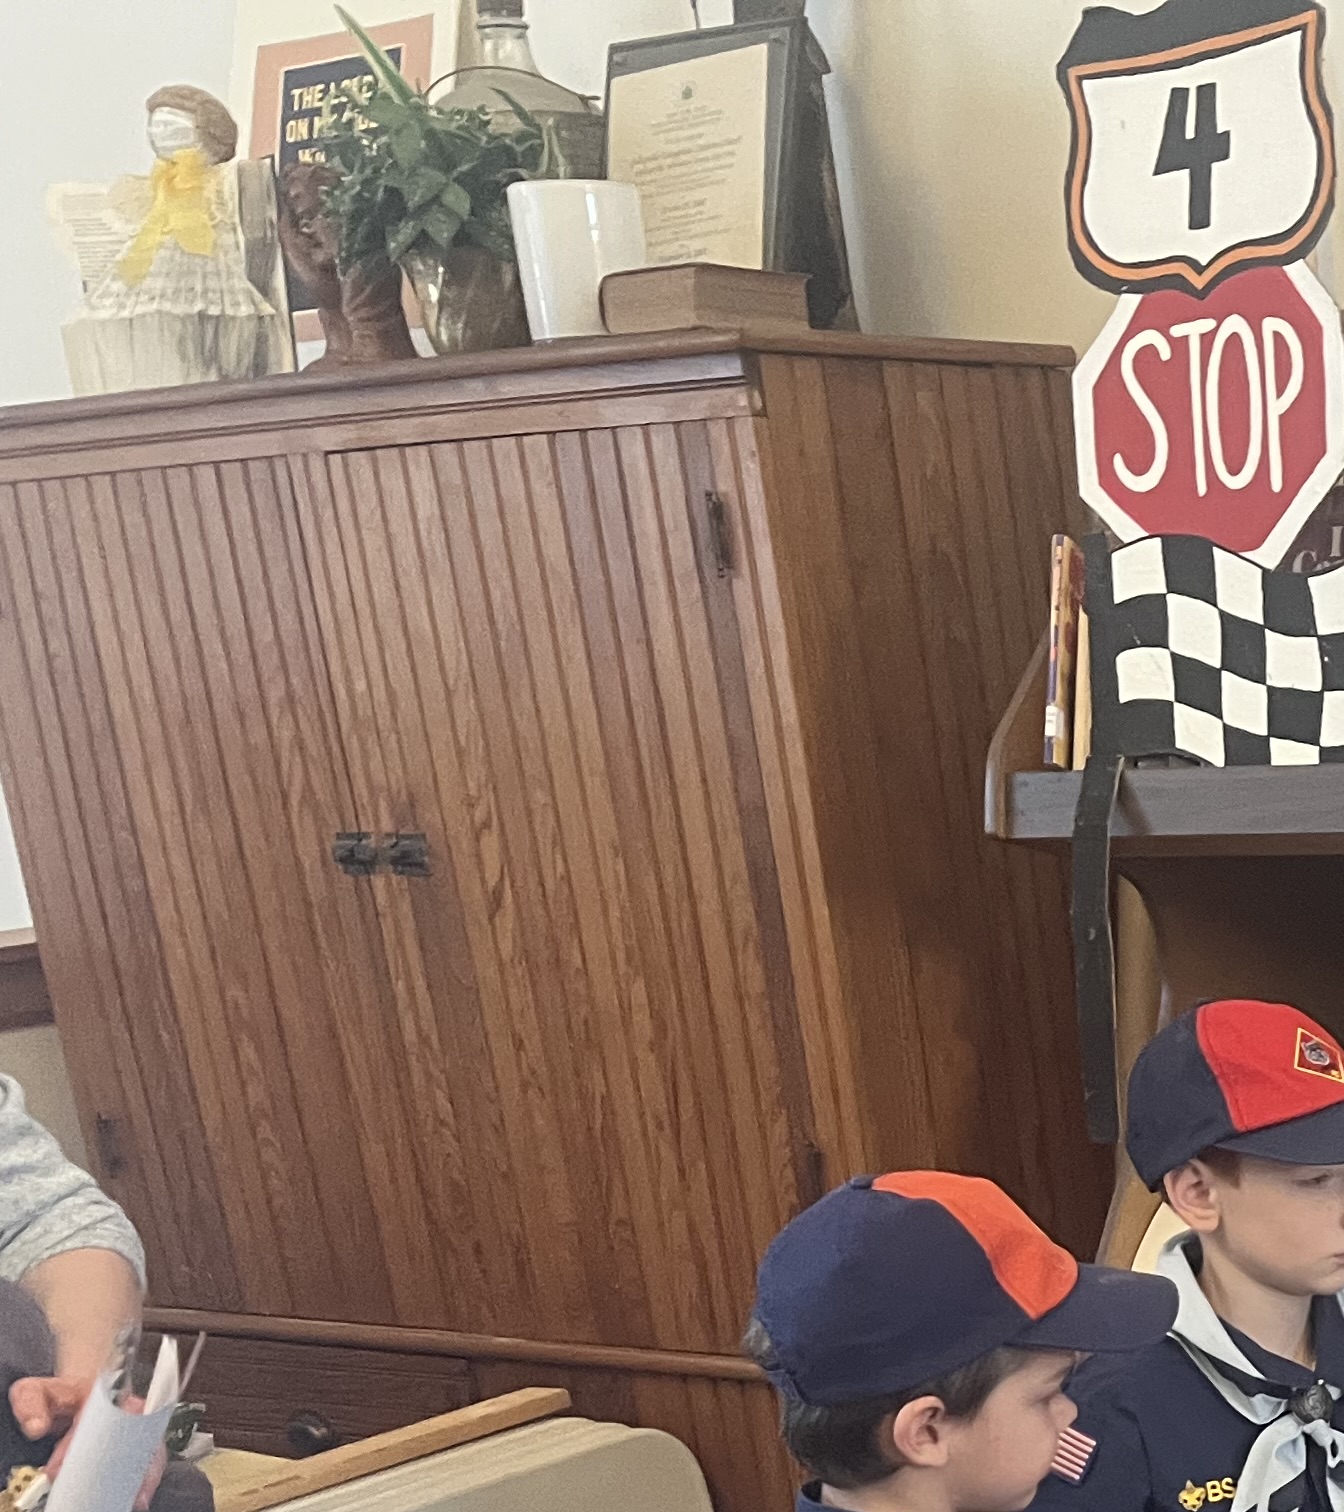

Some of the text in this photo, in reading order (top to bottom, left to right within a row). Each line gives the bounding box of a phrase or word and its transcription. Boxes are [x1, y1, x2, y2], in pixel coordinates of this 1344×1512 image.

[291, 84, 325, 111] THE
[1152, 82, 1231, 230] 4
[1113, 314, 1304, 496] STOP
